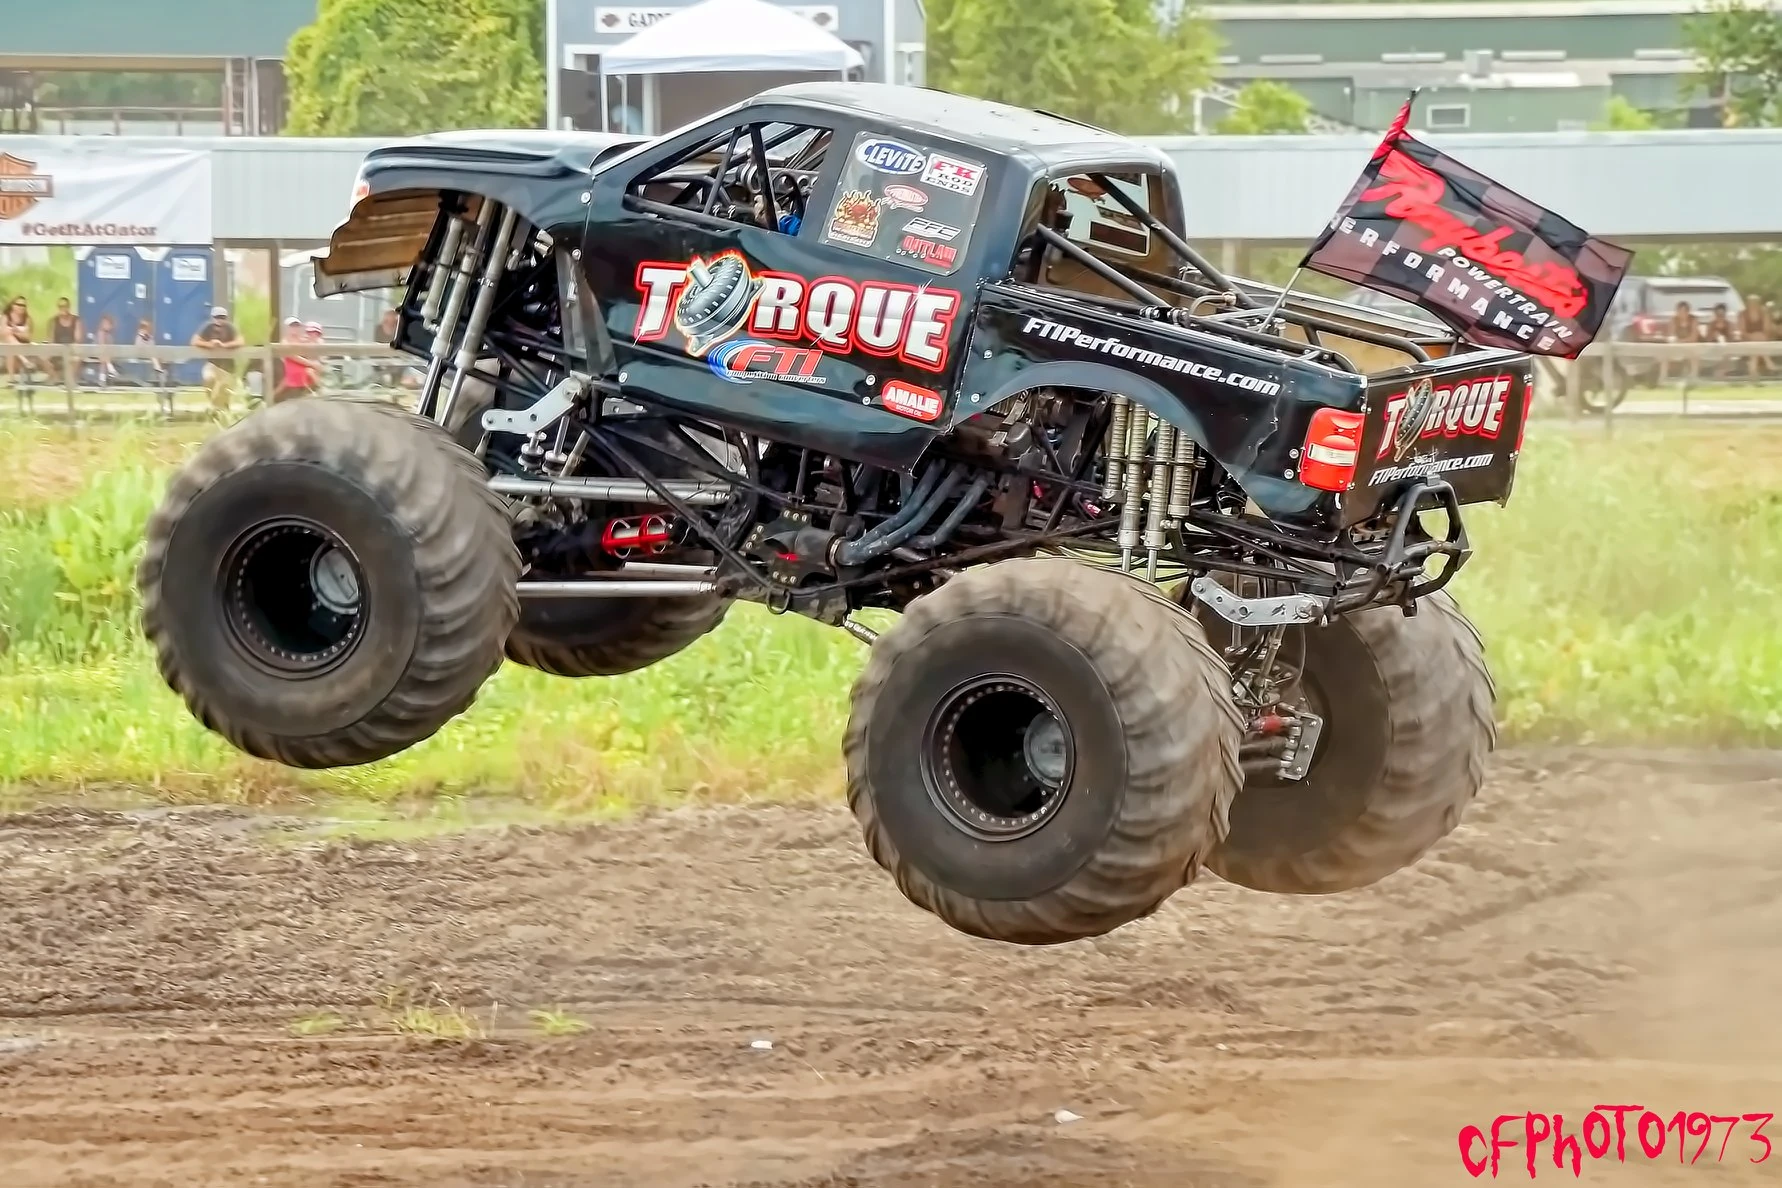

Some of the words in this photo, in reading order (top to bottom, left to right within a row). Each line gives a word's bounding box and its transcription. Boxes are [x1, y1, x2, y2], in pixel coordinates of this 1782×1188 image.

[925, 177, 971, 193] ENDS
[934, 160, 977, 181] FK
[938, 173, 973, 188] ROD
[21, 223, 158, 237] #GetItAtGator
[1437, 247, 1573, 339] POWERTRAIN
[731, 346, 824, 376] FTI
[1022, 317, 1281, 396] FTIPerformance.com
[886, 386, 939, 416] AMALIE
[1368, 453, 1494, 487] FTIPerformance.com
